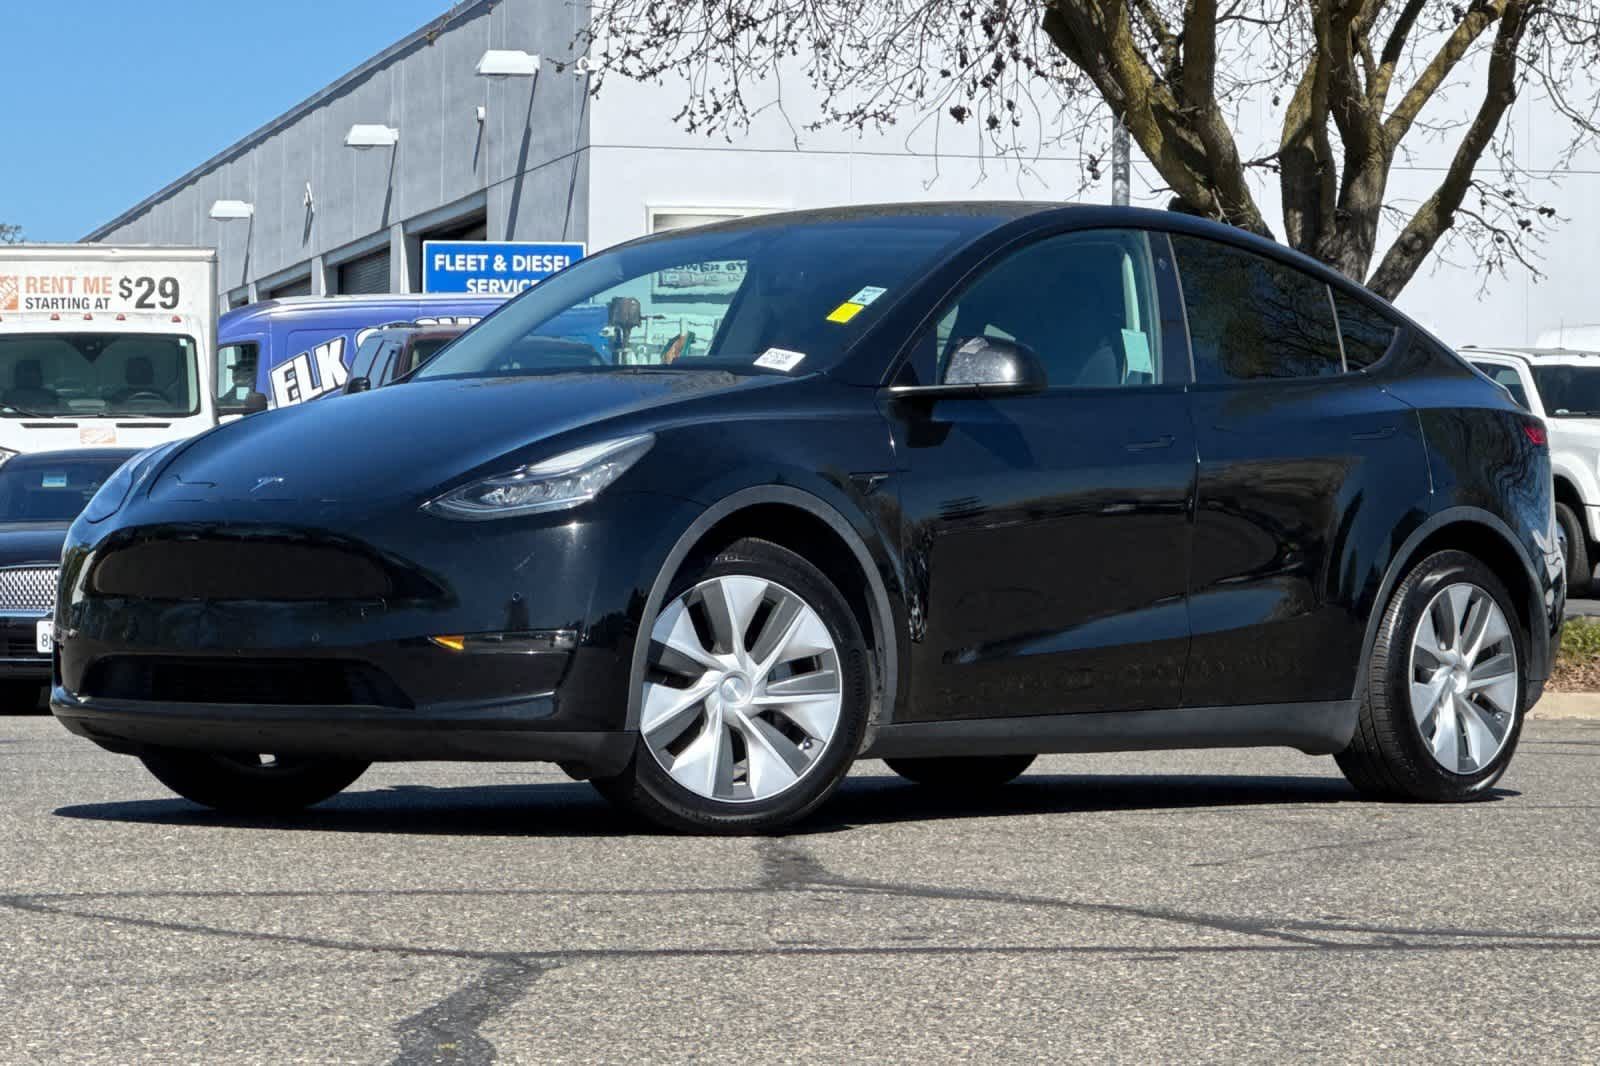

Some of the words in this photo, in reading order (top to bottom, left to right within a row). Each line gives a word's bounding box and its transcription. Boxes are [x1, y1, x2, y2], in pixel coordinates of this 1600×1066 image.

[434, 254, 488, 271] FLEET
[493, 254, 507, 271] &
[25, 276, 76, 294] RENT
[83, 276, 112, 294] ME
[118, 276, 180, 310] $29
[25, 297, 90, 310] STARTING
[94, 297, 111, 310] AT
[270, 337, 349, 408] ELK
